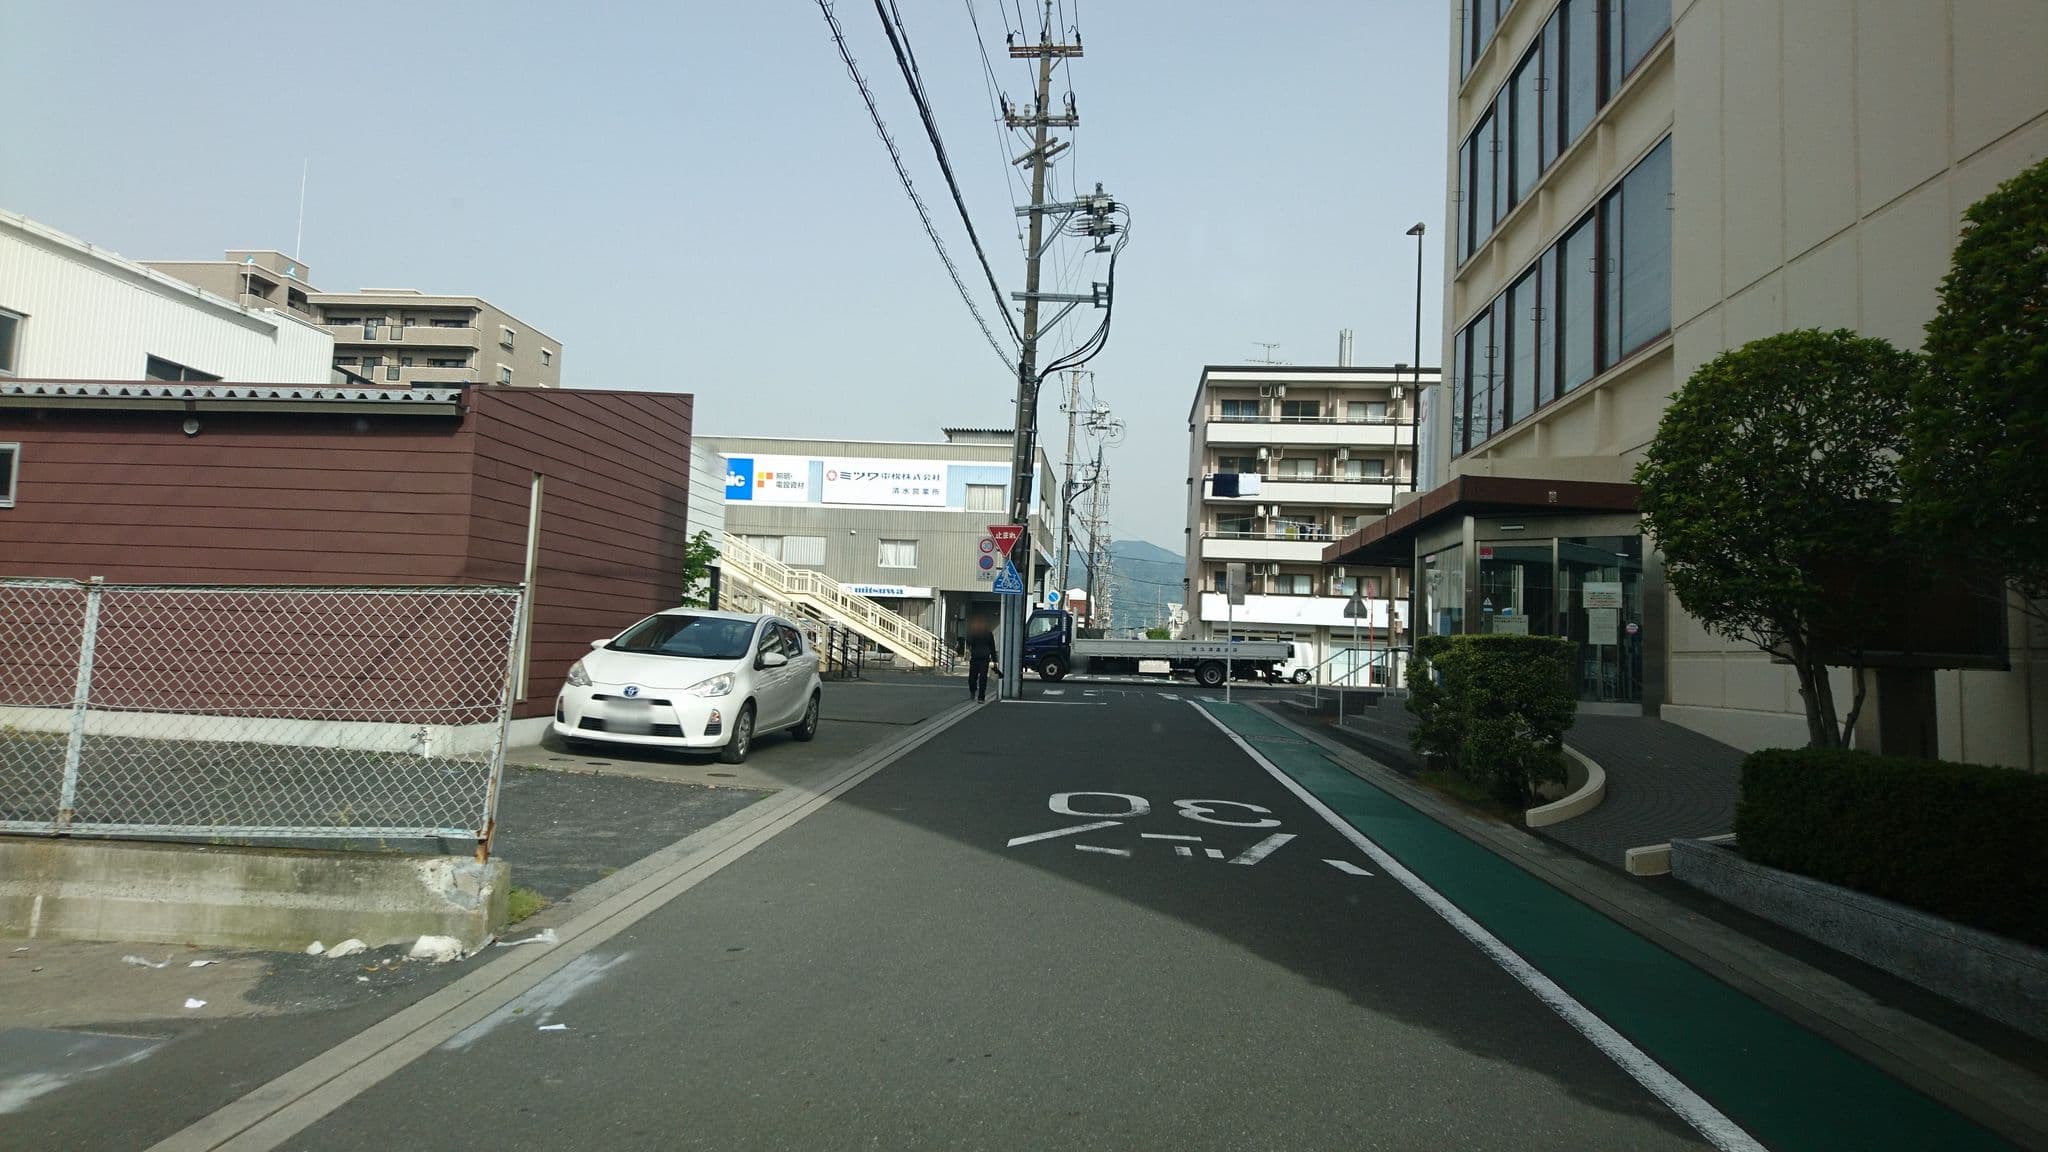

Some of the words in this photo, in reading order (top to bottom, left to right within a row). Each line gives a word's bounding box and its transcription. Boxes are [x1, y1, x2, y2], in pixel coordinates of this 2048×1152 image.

[995, 531, 1017, 539] 止まれ
[854, 586, 904, 595] mitsuwa
